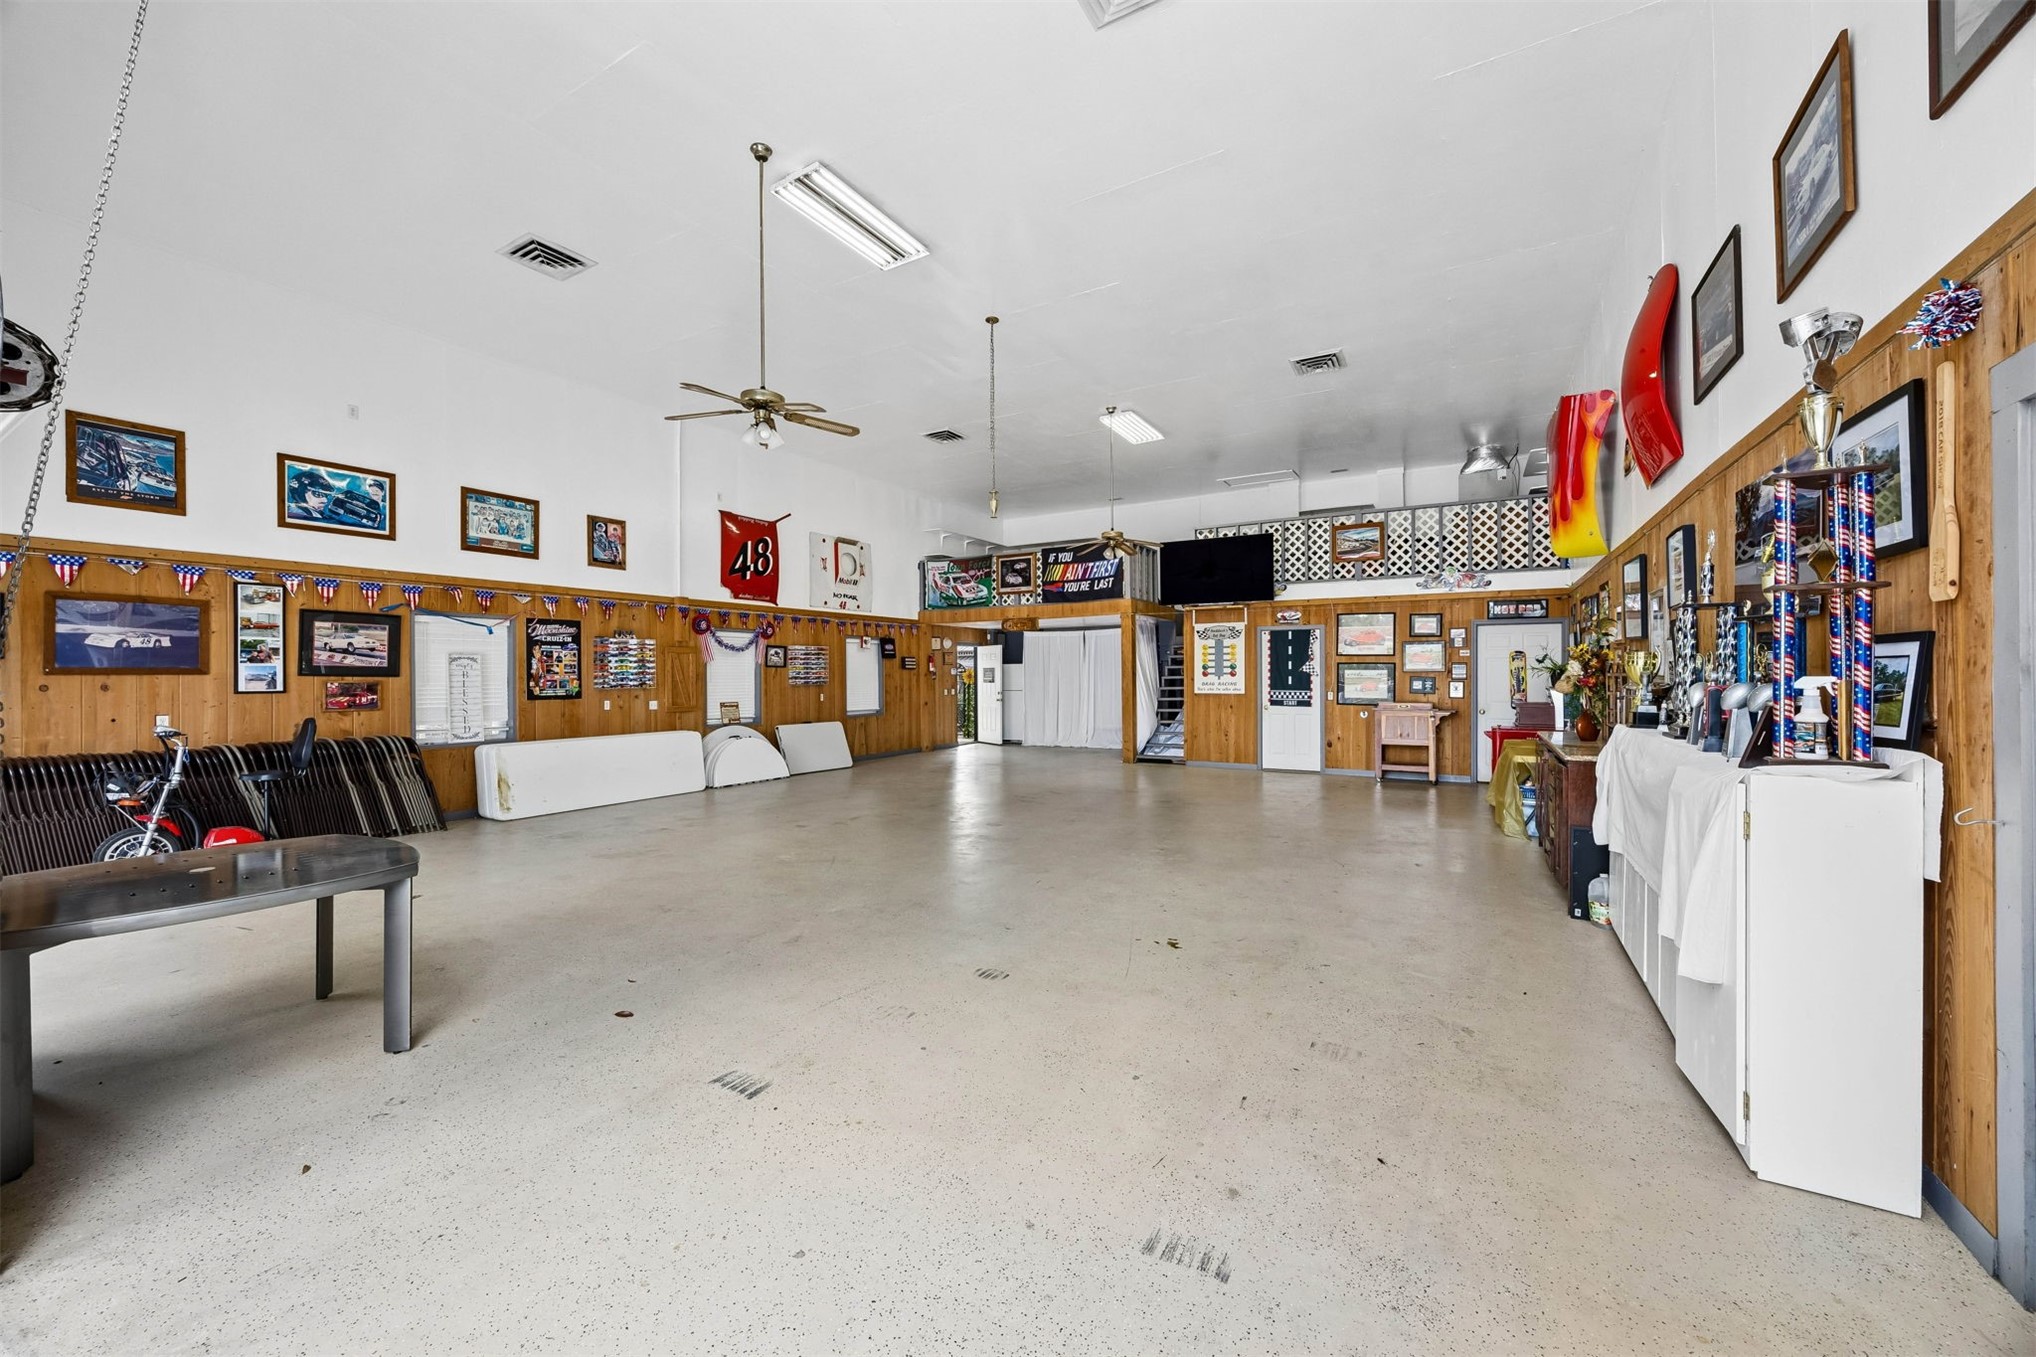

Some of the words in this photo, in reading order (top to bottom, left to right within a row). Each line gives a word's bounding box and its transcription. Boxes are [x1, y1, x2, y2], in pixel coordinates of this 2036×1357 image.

[728, 536, 773, 580] 48
[1048, 553, 1056, 563] IF
[1058, 552, 1073, 562] YOU
[1064, 562, 1094, 581] AIN'T
[1090, 558, 1120, 579] FIRST
[838, 577, 852, 585] Mobil
[1064, 581, 1091, 592] YOU'RE
[1094, 578, 1114, 590] LAST
[843, 593, 858, 601] FEAR
[1494, 604, 1516, 615] HOT
[528, 623, 577, 637] Moonshine
[140, 637, 151, 645] 48
[462, 670, 471, 734] BLESSED
